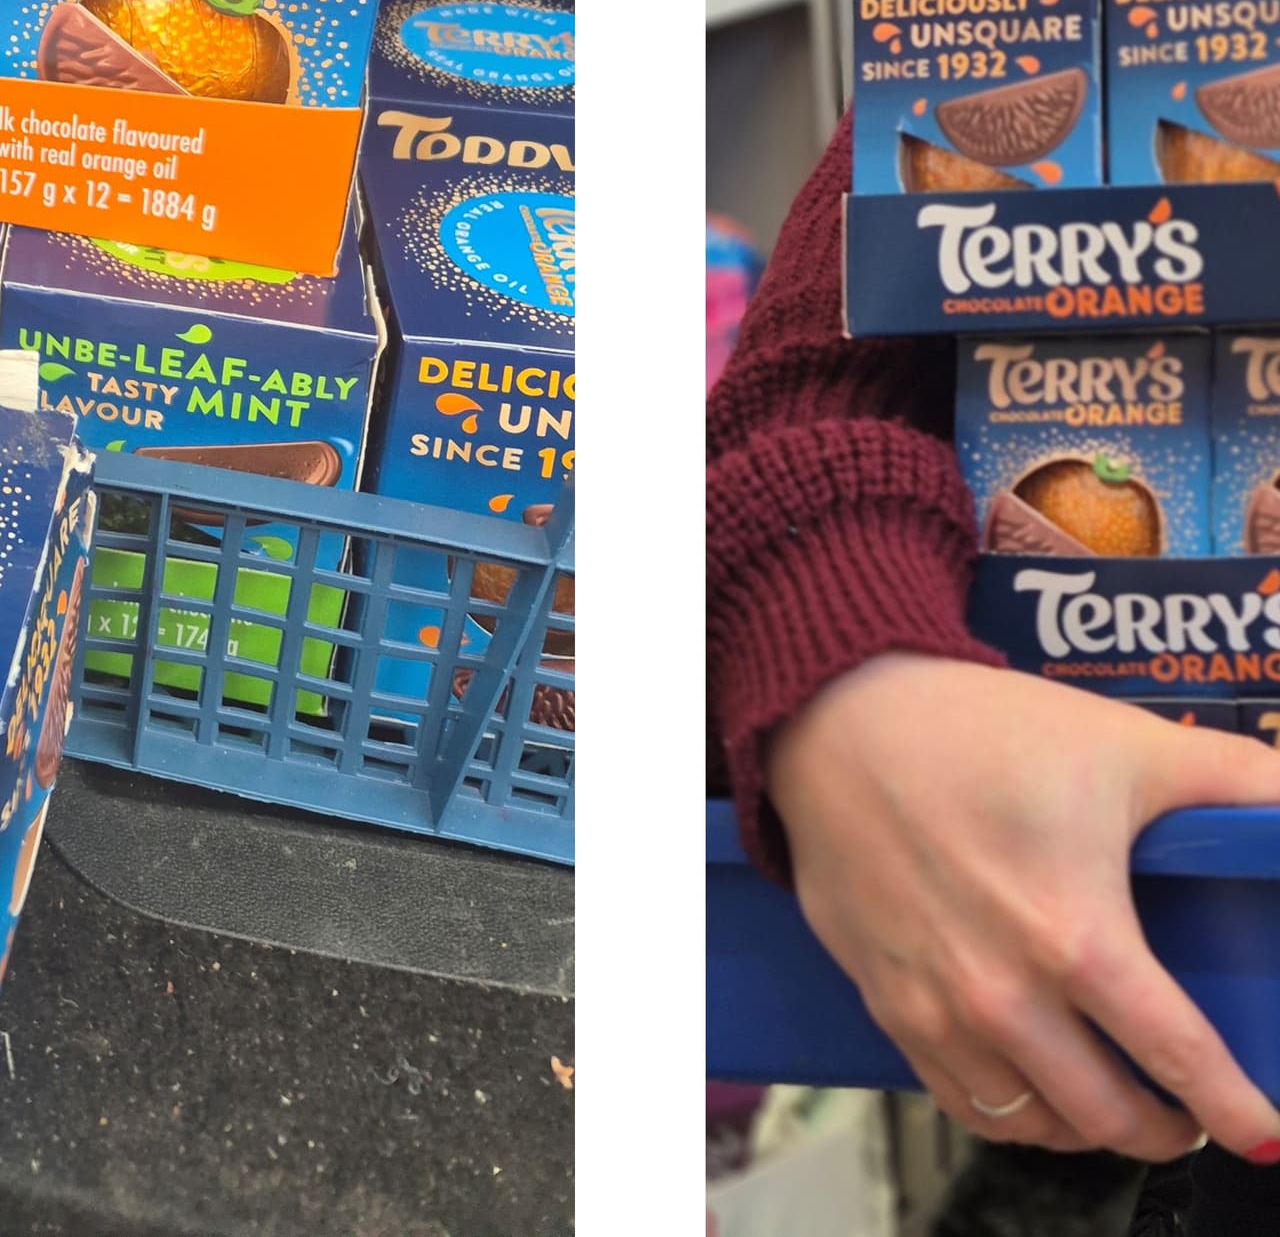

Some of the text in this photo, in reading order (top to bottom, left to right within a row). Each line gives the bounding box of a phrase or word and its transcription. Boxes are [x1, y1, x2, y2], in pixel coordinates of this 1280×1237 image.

[910, 14, 1084, 51] UNSQUARE
[1118, 32, 1268, 66] SINCE 1932
[861, 51, 1008, 82] SINCE 1932
[20, 109, 107, 144] chocolate
[112, 118, 205, 156] flavoured
[40, 142, 76, 168] real
[81, 152, 148, 182] orange
[153, 155, 178, 181] oil
[0, 167, 198, 222] 157 12 1884
[1044, 284, 1205, 318] ORANGE
[19, 327, 360, 402] UNBE-LEAF-ABLY
[38, 393, 165, 433] LAVOUR
[87, 371, 312, 430] TASTY MINT
[1065, 402, 1184, 427] ORANGE
[409, 433, 524, 472] SINCE
